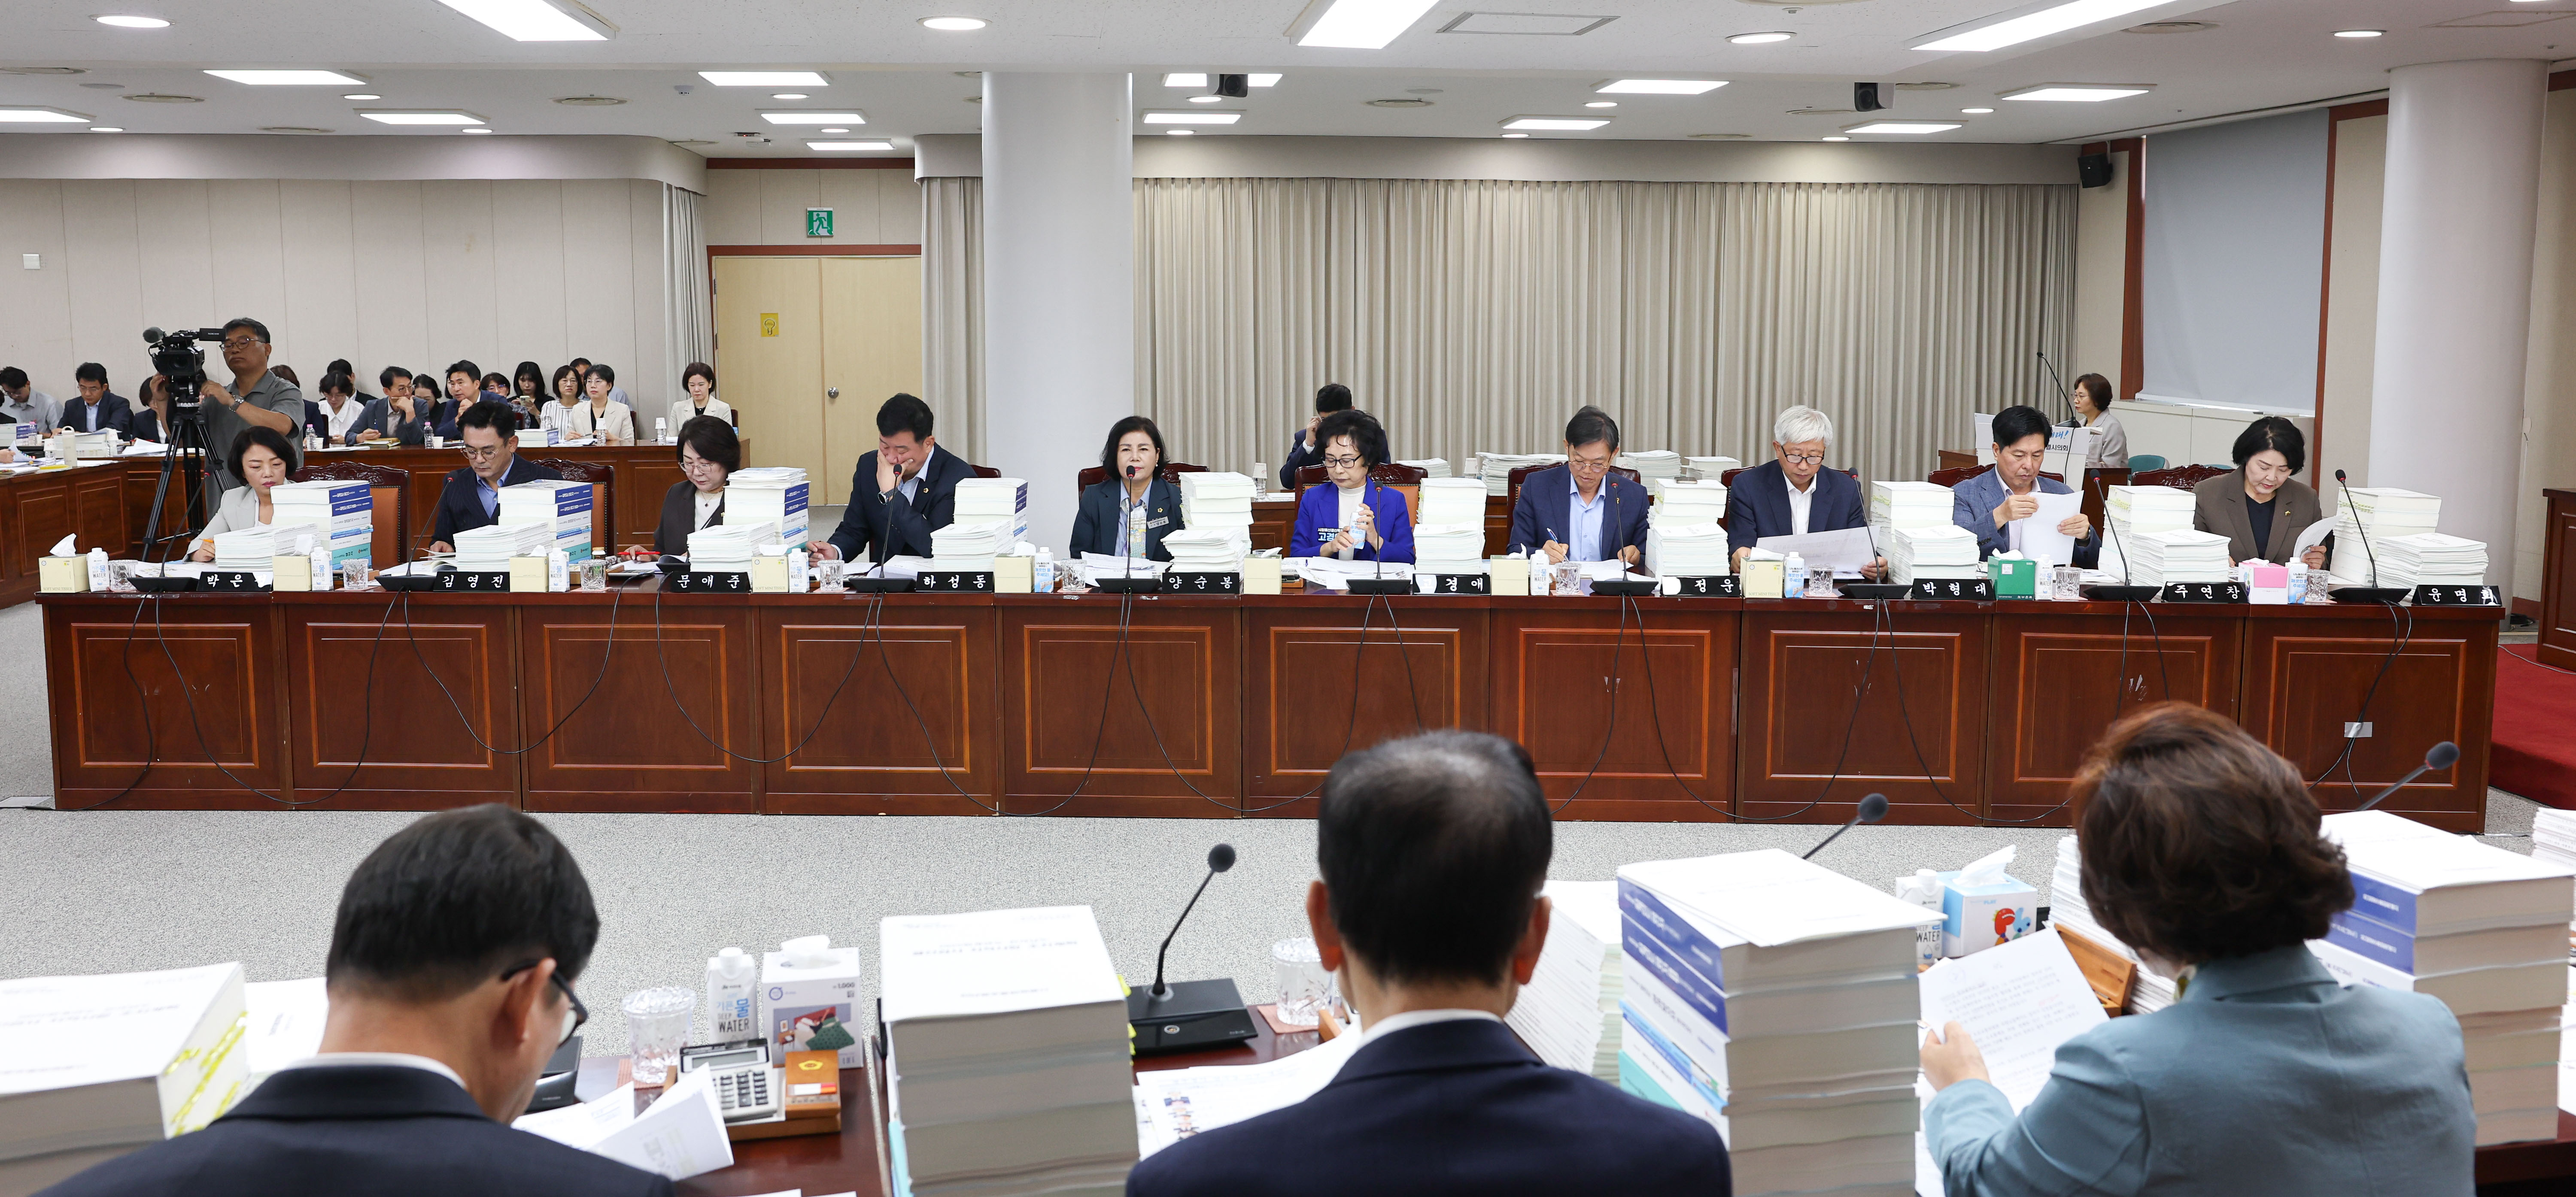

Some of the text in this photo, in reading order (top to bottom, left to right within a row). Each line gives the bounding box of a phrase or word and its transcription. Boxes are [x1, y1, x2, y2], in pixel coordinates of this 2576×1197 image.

[1318, 532, 1337, 541] 고경
[443, 575, 503, 588] 김영진
[923, 575, 985, 588] 하성동
[1169, 576, 1232, 589] 양순봉
[1923, 582, 1986, 596] 박형대
[2175, 585, 2240, 599] 주연창
[1916, 930, 1940, 942] WATER
[735, 998, 750, 1018] 물
[719, 1018, 749, 1033] WATER
